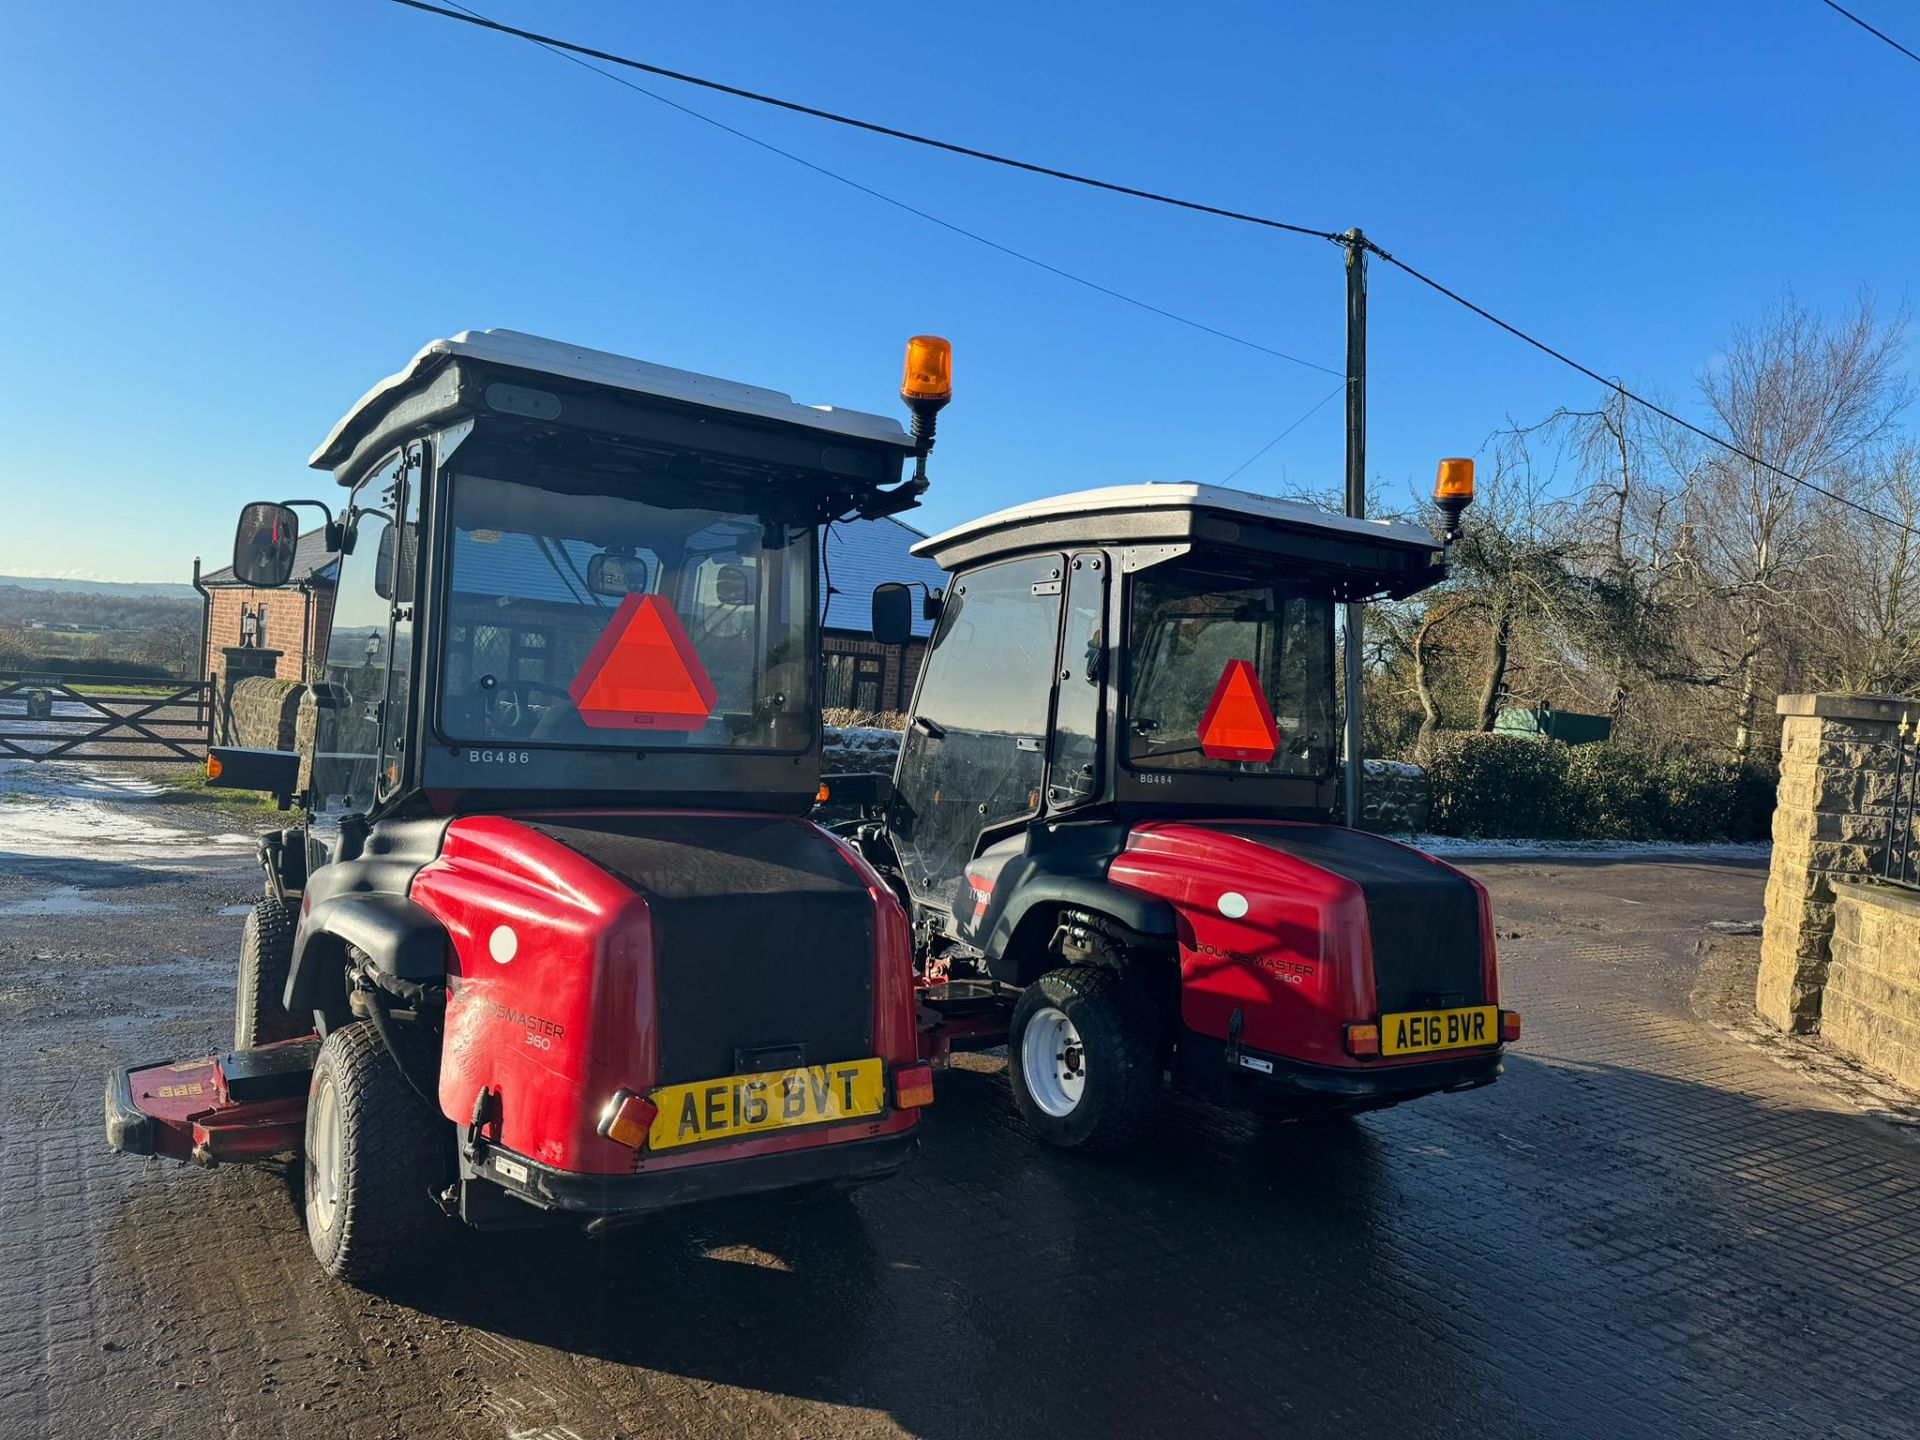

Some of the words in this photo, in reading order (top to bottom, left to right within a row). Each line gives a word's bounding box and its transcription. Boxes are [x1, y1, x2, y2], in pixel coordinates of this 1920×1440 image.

[469, 750, 529, 764] BG486
[1275, 970, 1302, 985] 360
[1396, 1015, 1442, 1049] AE16
[1447, 1012, 1486, 1043] BVR
[525, 1032, 551, 1051] 360
[677, 1081, 768, 1137] AE16
[782, 1065, 859, 1119] BVT
